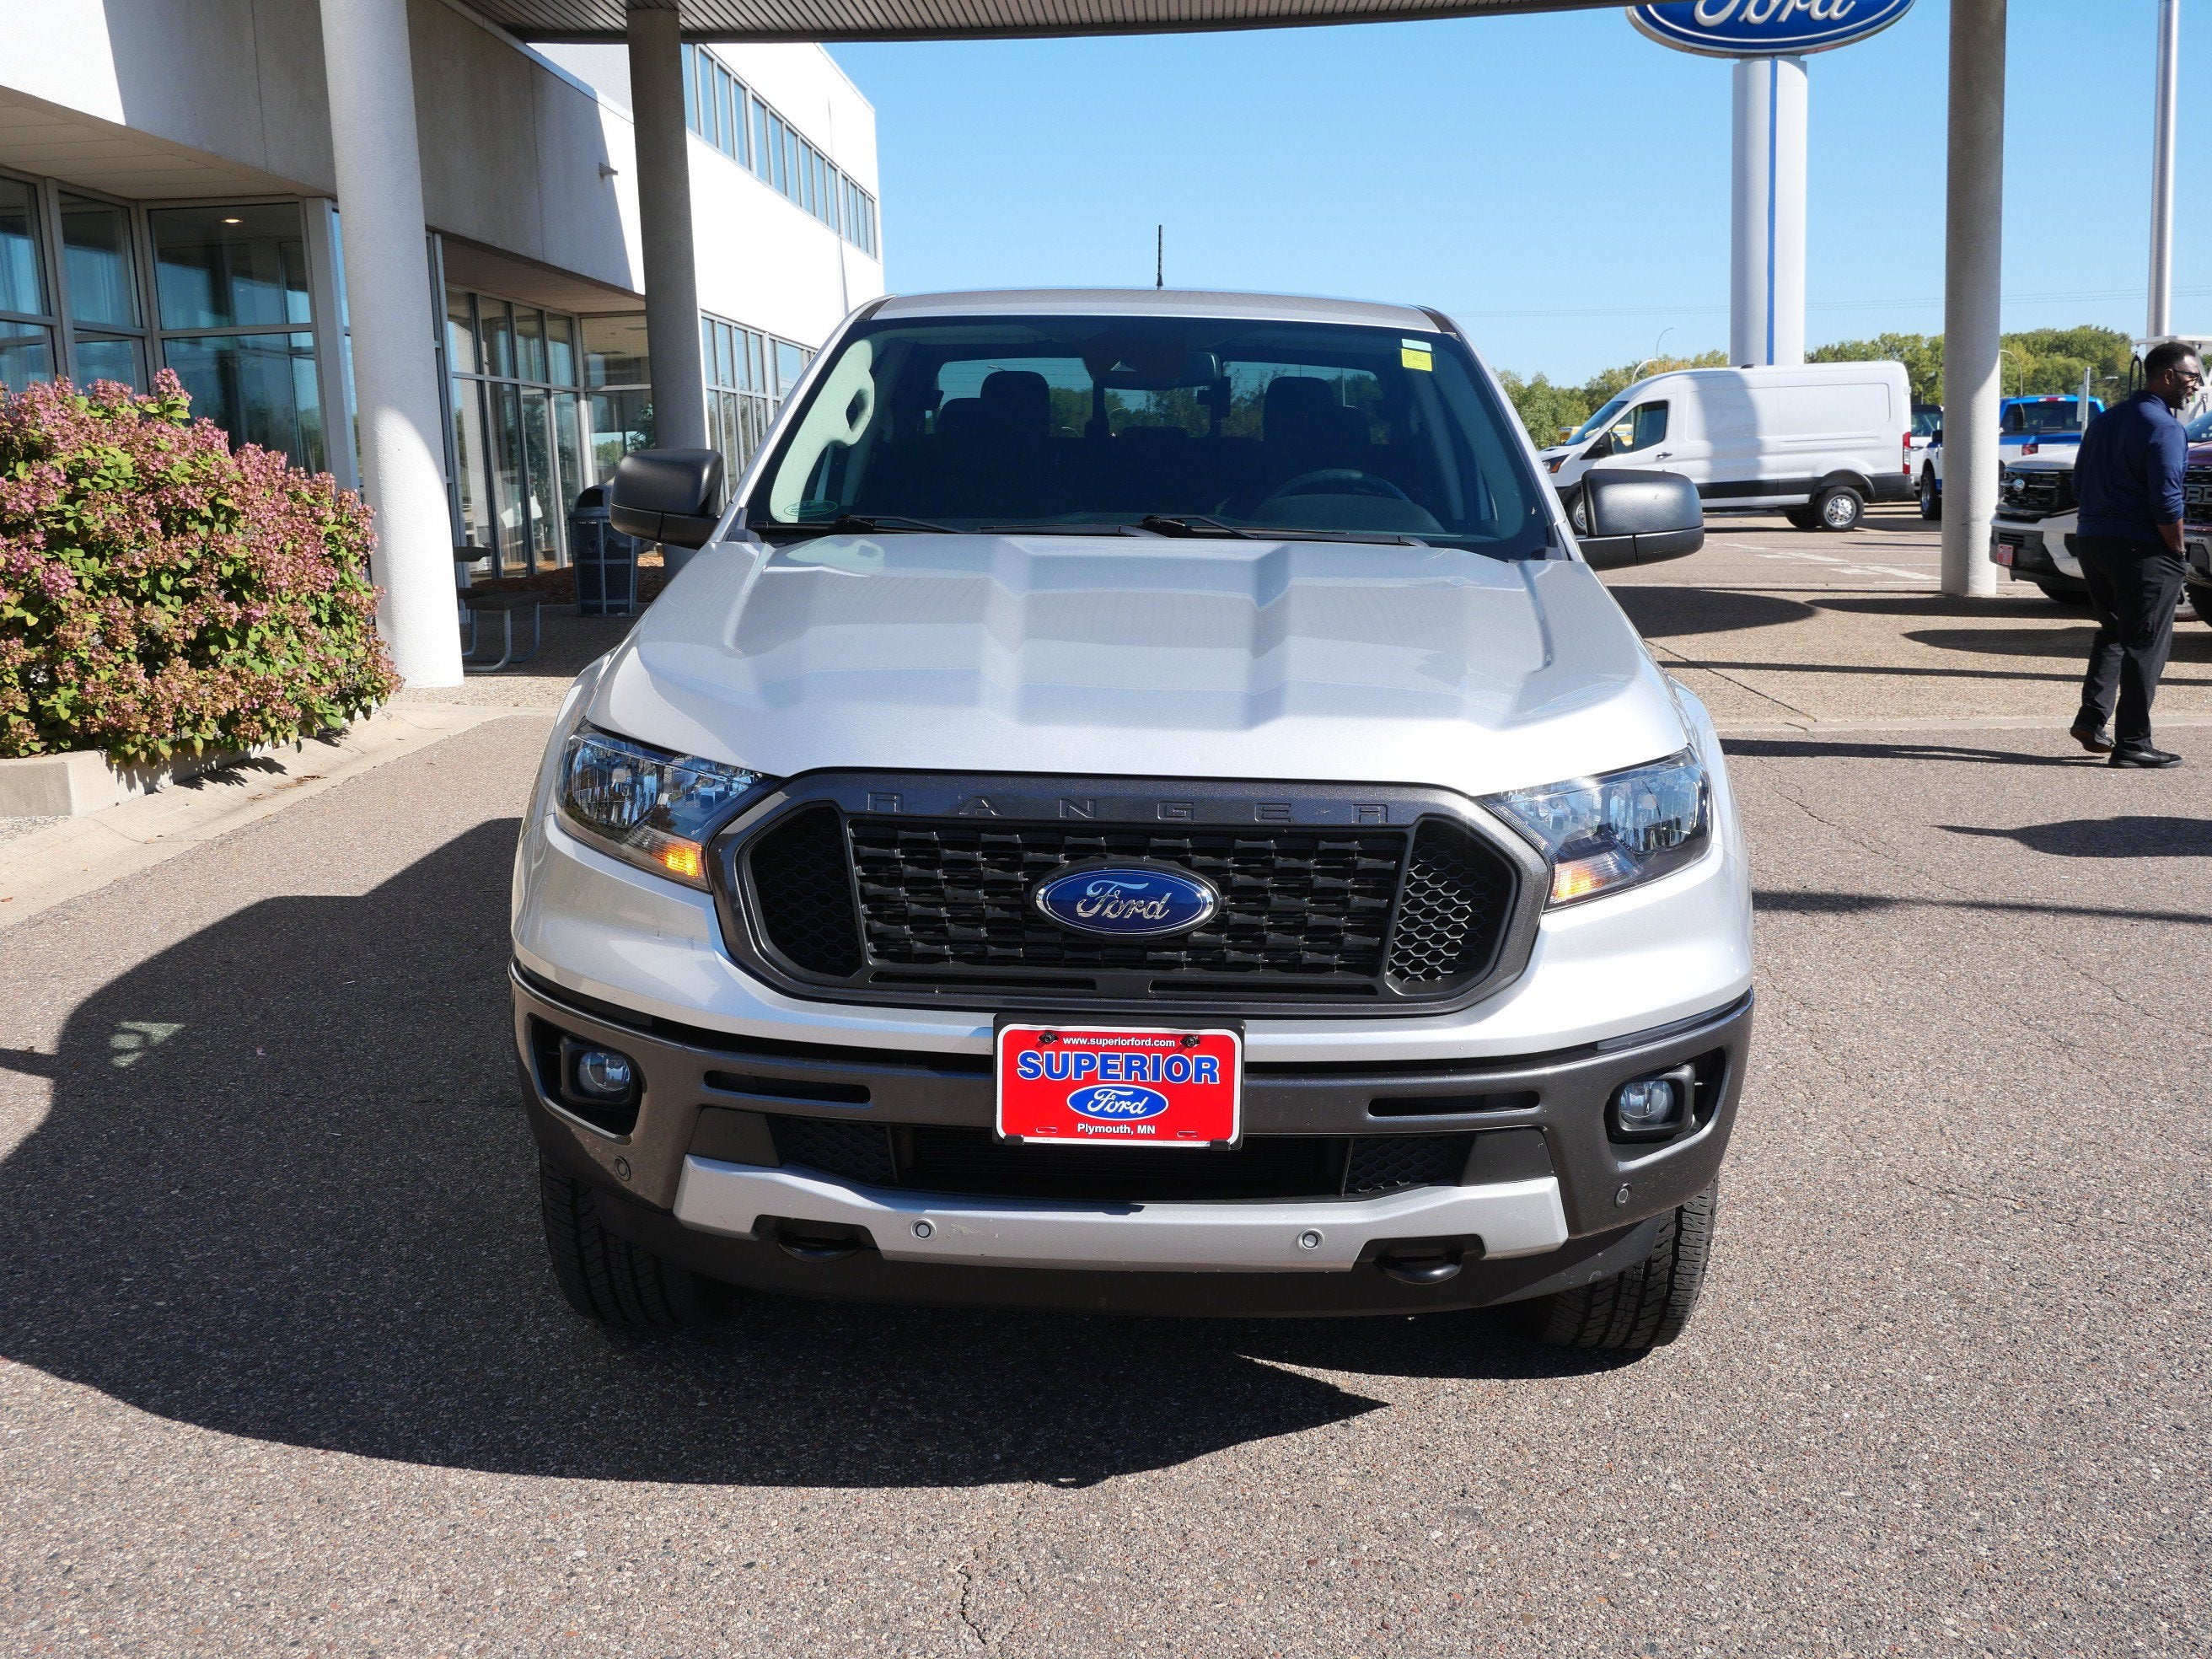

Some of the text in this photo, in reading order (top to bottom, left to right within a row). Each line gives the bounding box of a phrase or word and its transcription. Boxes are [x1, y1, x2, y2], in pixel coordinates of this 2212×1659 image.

[867, 791, 1389, 824] RANGER
[1076, 879, 1173, 920] Ford
[1062, 1036, 1175, 1048] www.superiorford.com
[1017, 1050, 1221, 1085] SUPERIOR
[1087, 1088, 1149, 1115] Ford
[1076, 1123, 1156, 1136] Plymouth, MN
